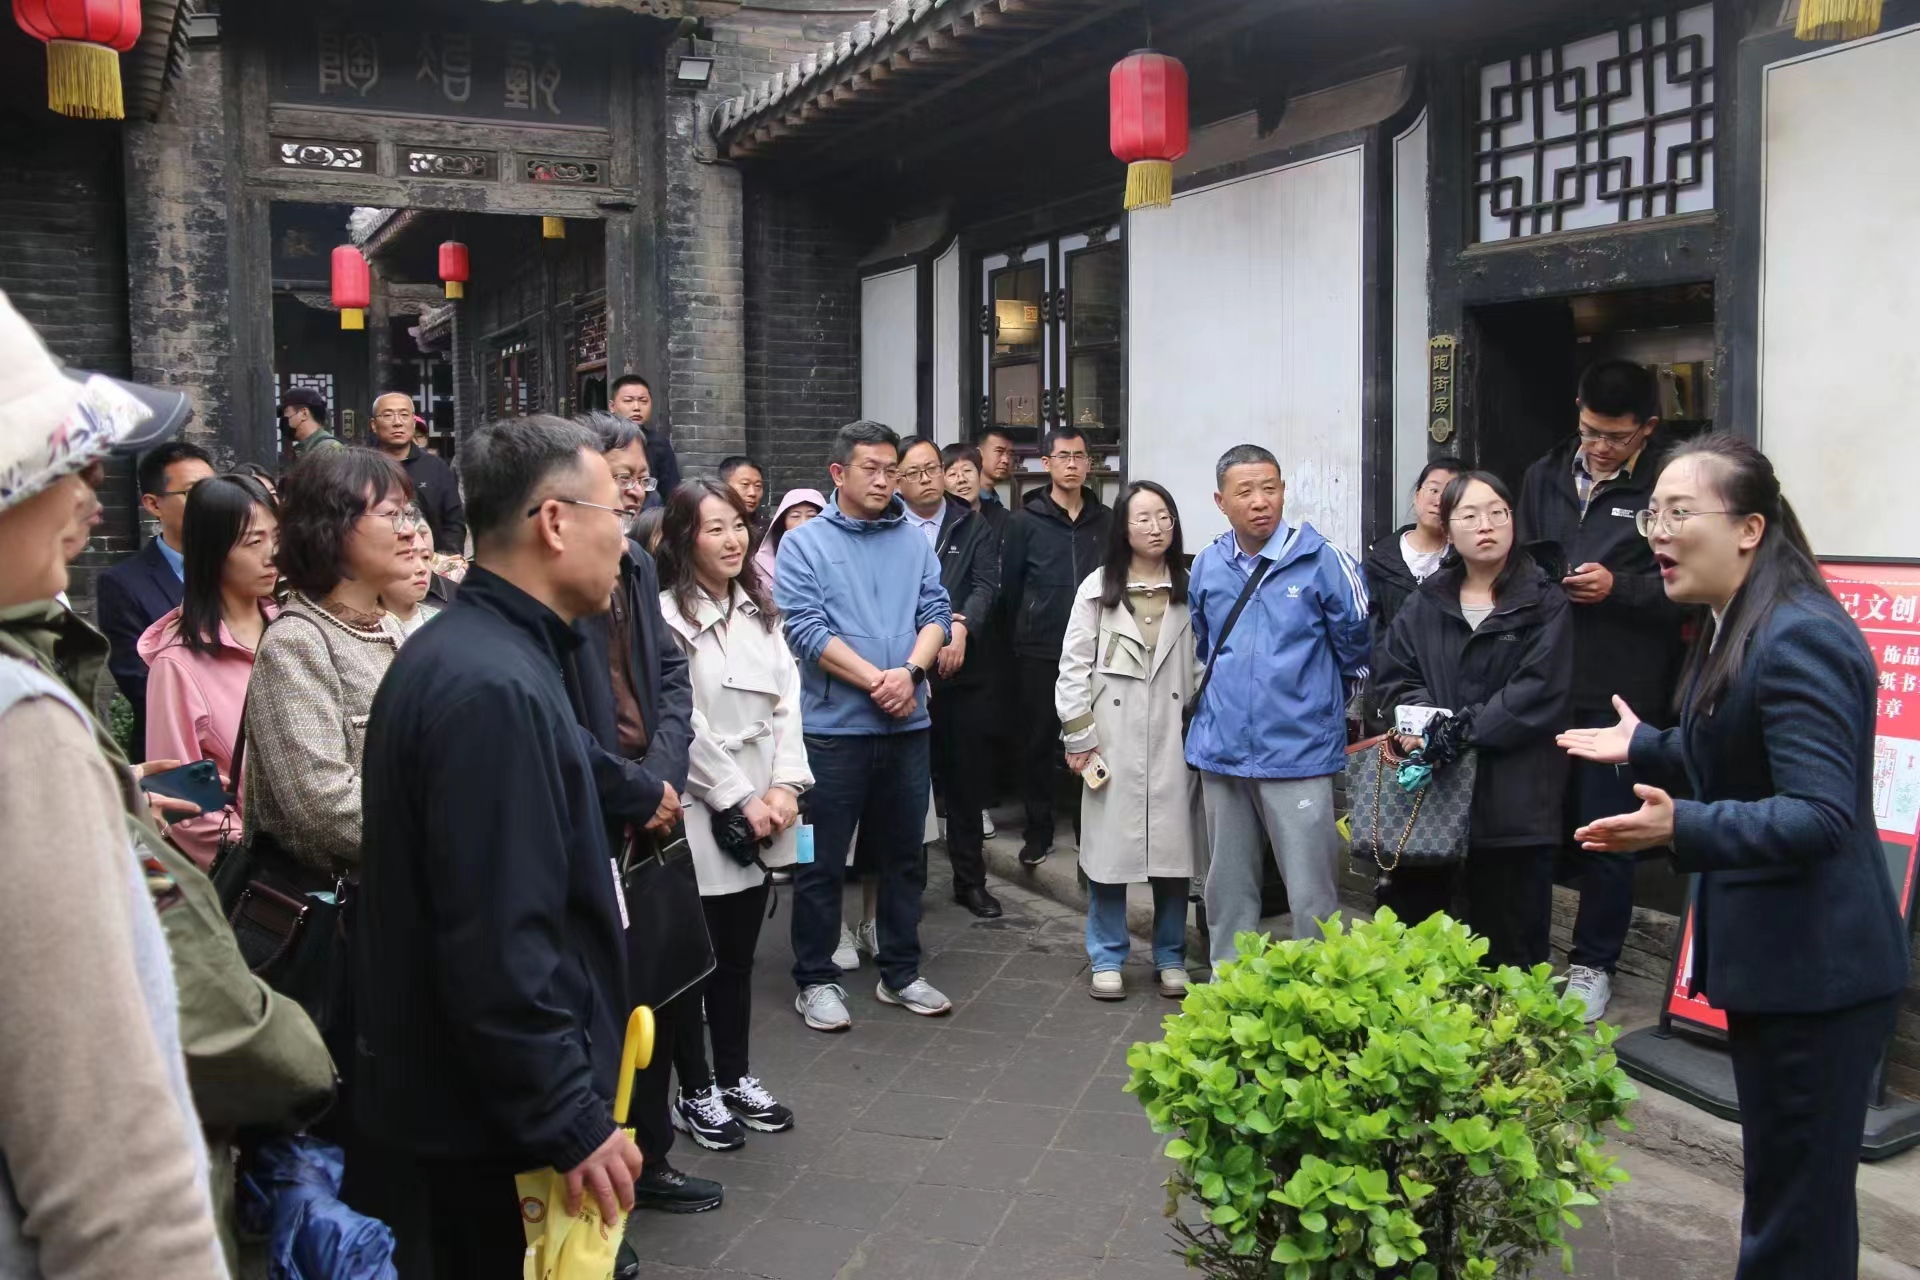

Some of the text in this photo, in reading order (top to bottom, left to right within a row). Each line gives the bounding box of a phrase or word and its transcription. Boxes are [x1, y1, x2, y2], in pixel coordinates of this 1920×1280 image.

[1433, 354, 1451, 414] 跑街房
[1839, 592, 1920, 623] 记文创
[1878, 671, 1920, 695] 纸书
